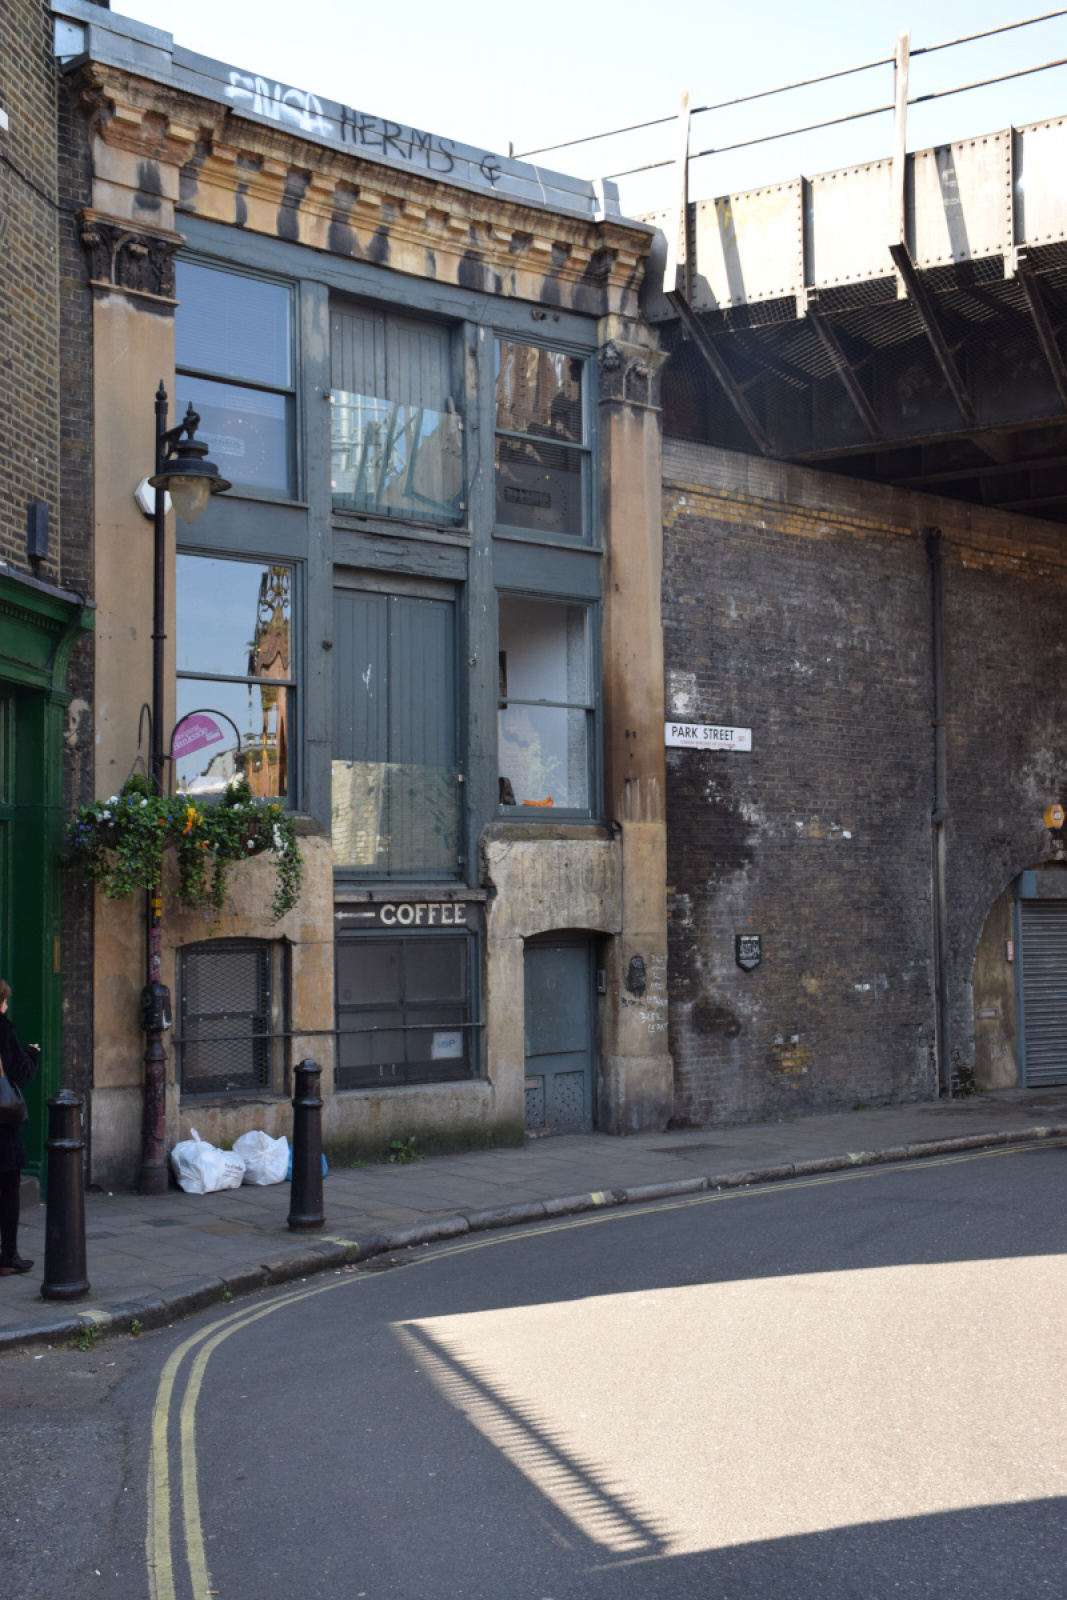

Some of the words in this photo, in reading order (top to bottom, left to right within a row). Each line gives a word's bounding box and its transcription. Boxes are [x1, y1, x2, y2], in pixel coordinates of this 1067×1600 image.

[671, 726, 698, 739] PARK
[703, 728, 734, 741] STREET
[380, 903, 466, 925] COFFEE
